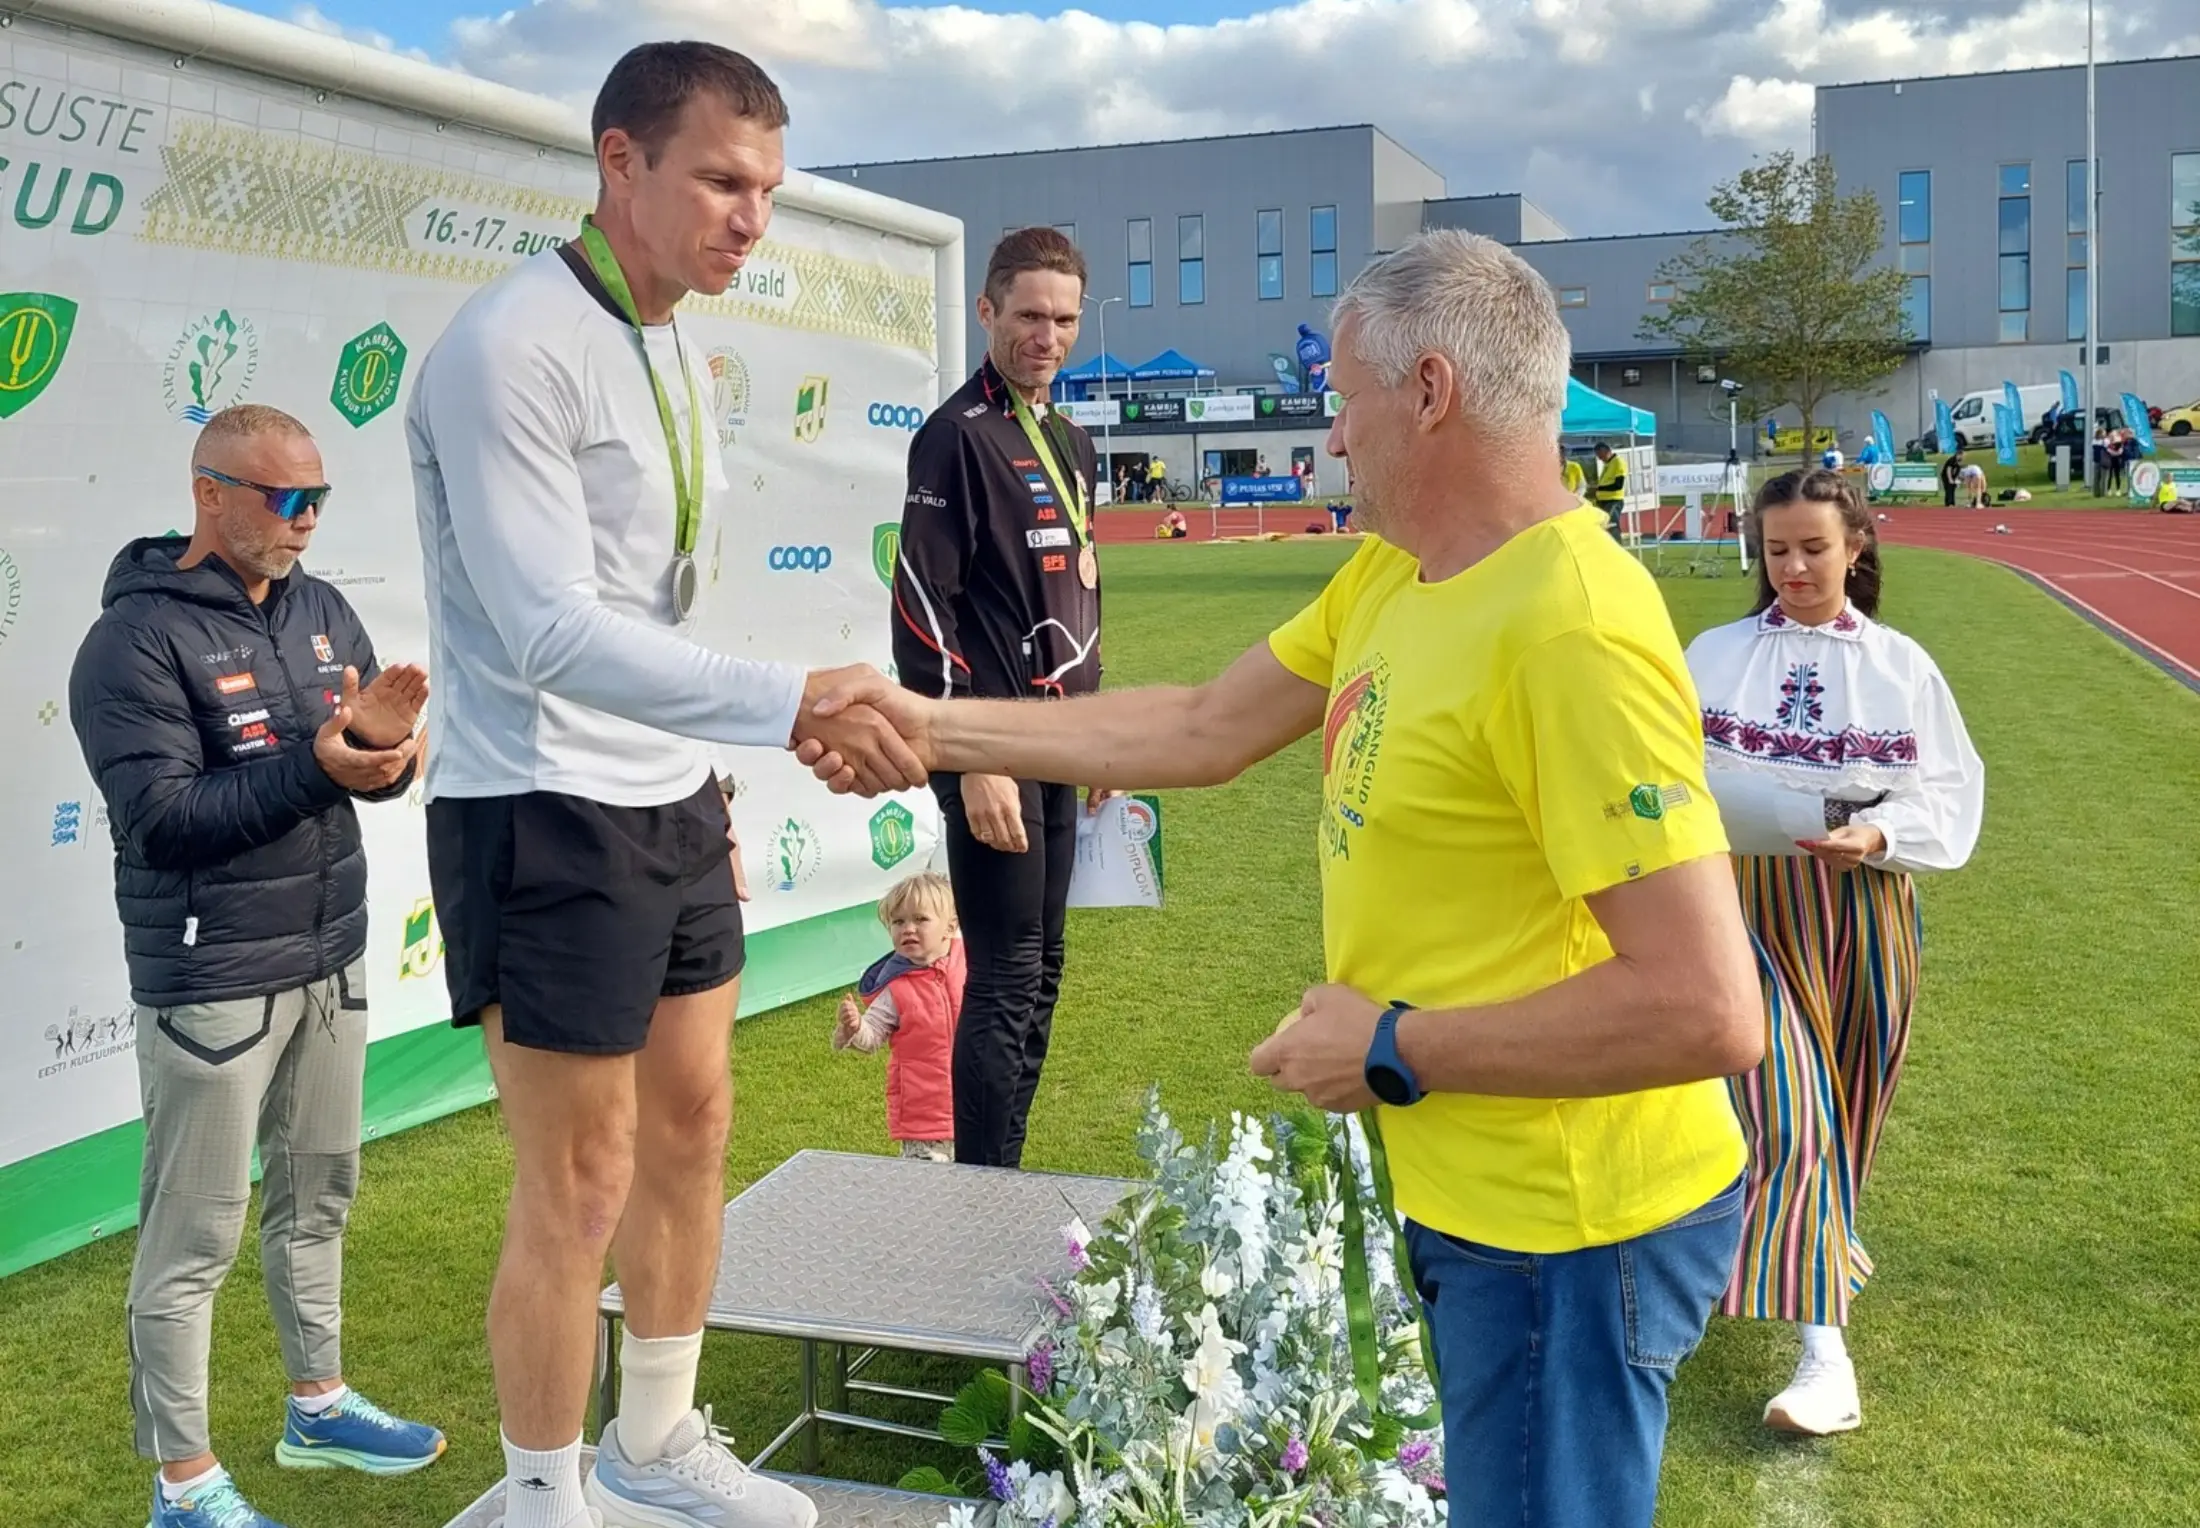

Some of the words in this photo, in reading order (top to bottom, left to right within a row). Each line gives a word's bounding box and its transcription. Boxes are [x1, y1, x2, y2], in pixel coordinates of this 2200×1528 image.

[0, 81, 154, 154] SUSTE
[0, 157, 124, 236] UD
[424, 208, 506, 251] 16.-17.
[512, 231, 567, 256] au
[747, 269, 785, 298] vald
[163, 314, 211, 413] TARTUMAA
[223, 317, 258, 409] SPORDILII
[355, 334, 397, 356] KAMBJA
[868, 402, 924, 432] coop
[922, 495, 947, 508] VALD
[769, 546, 832, 573] coop
[0, 547, 20, 646] PORDILI
[1124, 843, 1152, 897] DIPLOM
[38, 1061, 67, 1079] EESTI
